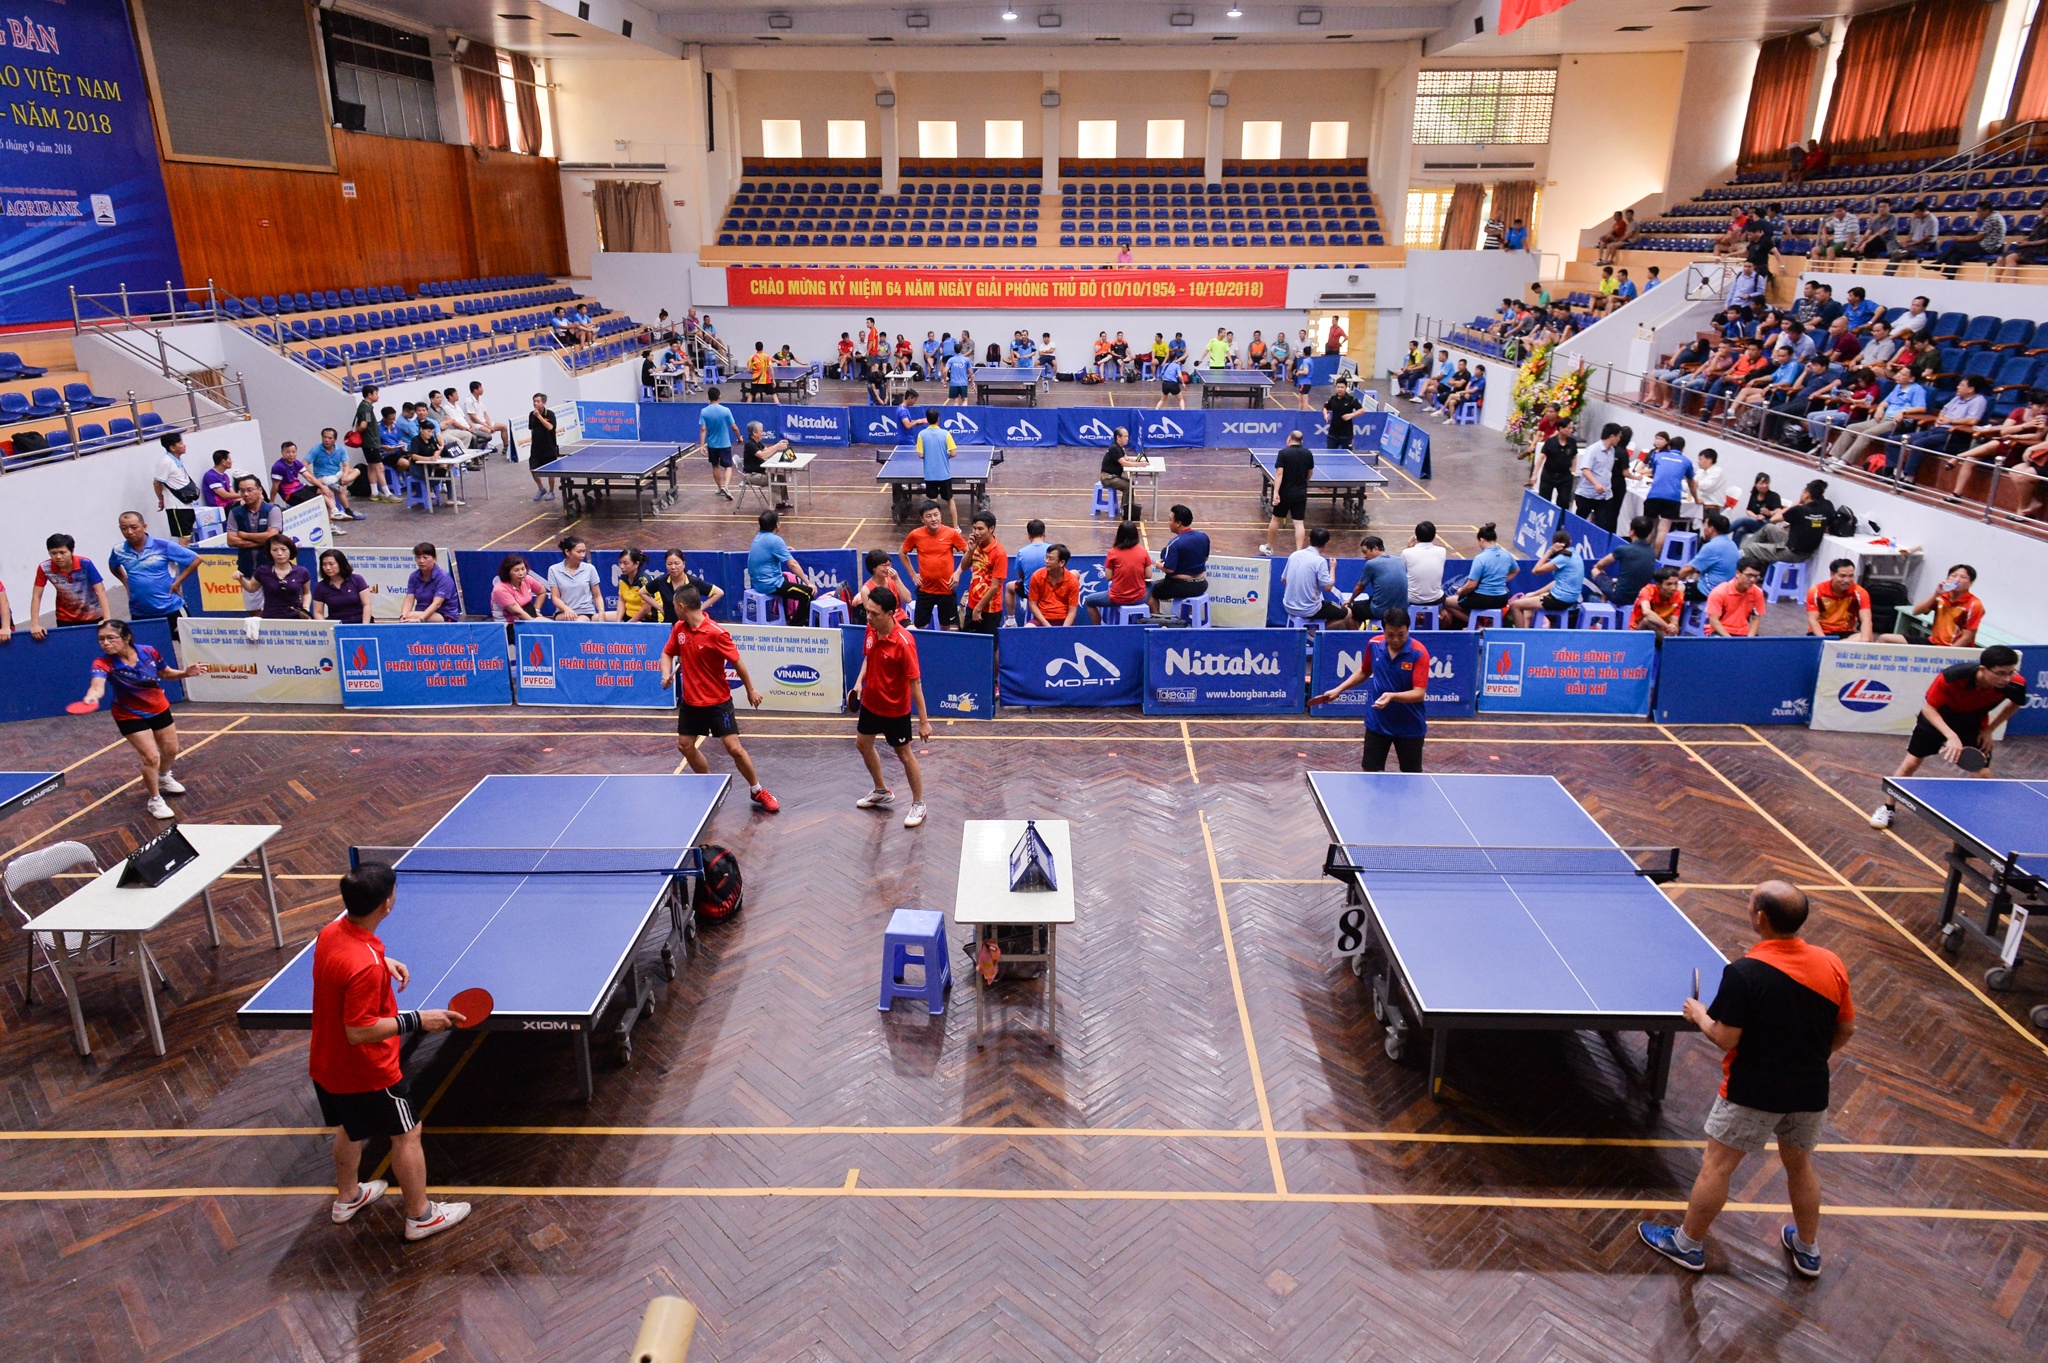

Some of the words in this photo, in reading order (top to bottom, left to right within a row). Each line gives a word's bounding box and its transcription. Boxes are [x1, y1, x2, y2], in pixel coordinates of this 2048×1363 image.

[7, 15, 60, 55] BÀN
[23, 66, 71, 98] VIỆT
[76, 75, 122, 102] NAM
[10, 99, 61, 131] NĂM
[63, 109, 113, 135] 2018
[6, 138, 29, 154] tháng
[29, 141, 35, 151] 9
[36, 142, 53, 154] năm
[54, 143, 73, 155] 2018
[6, 200, 83, 217] AGRIBANK
[750, 278, 785, 295] CHÀO
[788, 277, 827, 296] MỪNG
[829, 275, 846, 296] KỶ
[850, 278, 883, 299] NIỆM
[885, 281, 902, 296] 64
[905, 278, 935, 297] NĂM
[938, 279, 973, 297] NGÀY
[975, 276, 1001, 297] GIẢI
[1005, 278, 1049, 297] PHÓNG
[1052, 275, 1076, 297] THỦ
[1079, 278, 1098, 297] ĐÔ
[1101, 281, 1176, 298] (10/10/1954
[1188, 281, 1264, 298] 10/10/2018)
[1222, 422, 1277, 434] XIOM
[214, 628, 227, 636] LÔNG
[281, 629, 299, 637] THÀNH
[299, 629, 310, 637] PHỐ
[193, 637, 210, 645] TRANH
[210, 636, 221, 644] CÚP
[233, 637, 245, 645] TUỔI
[580, 640, 605, 655] TỔNG
[607, 642, 634, 655] CÔNG
[635, 643, 647, 655] TY
[771, 636, 783, 644] VIÊN
[783, 635, 800, 645] THÀNH
[801, 636, 812, 645] PHỐ
[821, 638, 829, 646] NỘI
[407, 641, 434, 655] TỔNG
[437, 643, 465, 655] CÔNG
[467, 644, 479, 655] TY
[747, 643, 757, 651] TRẺ
[757, 644, 767, 652] THỦ
[775, 645, 785, 653] LẦN
[805, 646, 817, 654] NĂM
[817, 647, 830, 655] 2017
[1553, 647, 1579, 662] TỔNG
[1582, 650, 1610, 662] CÔNG
[1613, 651, 1625, 662] TY
[385, 658, 414, 672] PHÂN
[416, 659, 438, 672] BÓN
[439, 658, 453, 671] VÀ
[455, 658, 475, 671] HÓA
[478, 657, 504, 670] CHẤT
[559, 656, 585, 670] PHÂN
[587, 657, 608, 671] BÓN
[609, 657, 621, 671] VÀ
[624, 657, 643, 671] HÓA
[1836, 652, 1849, 660] GIẢI
[1849, 652, 1862, 660] CẦU
[1863, 653, 1879, 661] LÔNG
[1880, 653, 1892, 662] HỌC
[1929, 657, 1944, 665] VIÊN
[266, 665, 322, 676] VietinBank
[1528, 665, 1557, 678] PHÂN
[1558, 666, 1580, 679] BÓN
[1582, 665, 1596, 679] VÀ
[1598, 665, 1618, 679] HÓA
[1621, 664, 1648, 679] CHẤT
[1836, 661, 1854, 669] TRANH
[1855, 661, 1867, 670] CÚP
[1883, 663, 1896, 672] TUỔI
[1897, 664, 1909, 672] TRẺ
[426, 673, 447, 687] DẦU
[450, 673, 467, 686] KHÍ
[523, 677, 553, 685] PVFCCo
[595, 672, 615, 687] DẦU
[617, 673, 634, 686] KHÍ
[776, 669, 818, 680] VINAMILK
[348, 680, 380, 689] PVFCCo
[1045, 677, 1121, 688] MOFIT
[1486, 685, 1518, 694] PVFCCo
[1565, 680, 1586, 694] DẦU
[1588, 681, 1607, 695] KHÍ
[799, 689, 811, 698] VIỆT
[1206, 688, 1287, 701] www.bongban.asia
[1846, 679, 1892, 701] LILAMA
[22, 782, 59, 806] CHAMPION
[1886, 787, 1917, 812] CHAMPION
[1337, 909, 1366, 952] 8
[596, 980, 619, 1019] CHAMPION
[523, 1021, 568, 1030] XIOM
